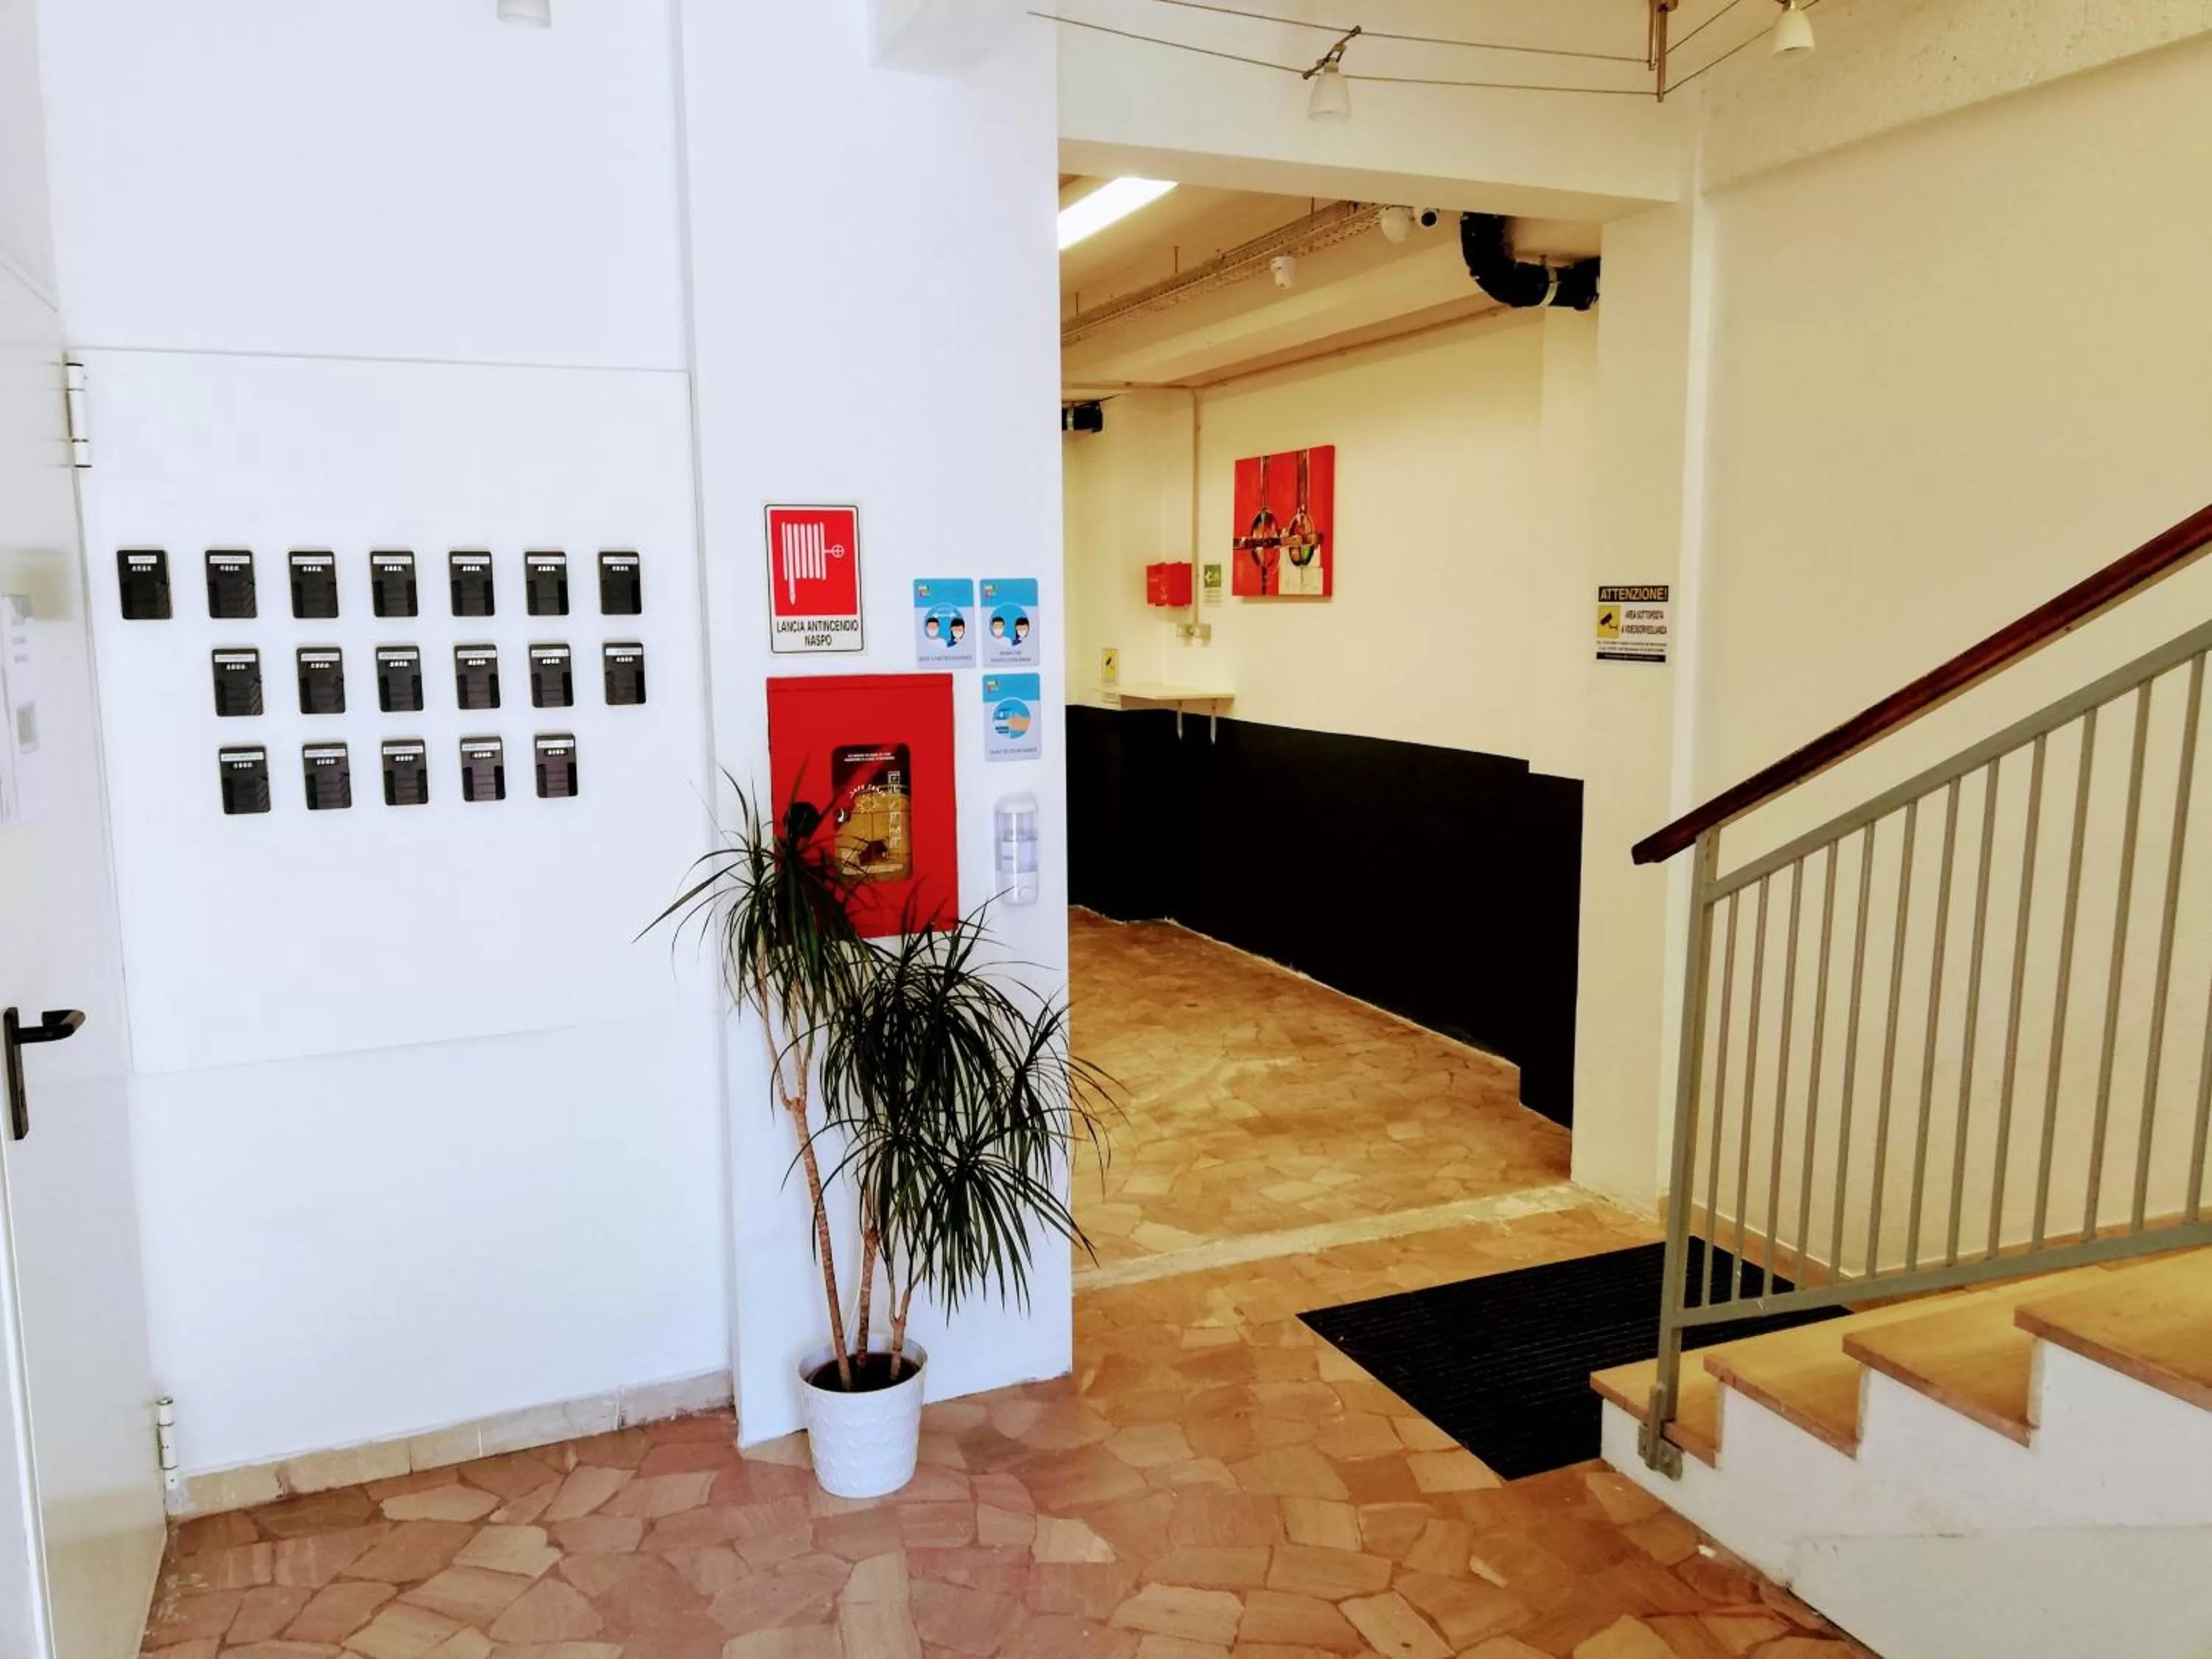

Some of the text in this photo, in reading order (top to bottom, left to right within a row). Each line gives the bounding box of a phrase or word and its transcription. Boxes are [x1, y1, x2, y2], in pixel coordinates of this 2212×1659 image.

[776, 619, 859, 633] LANCIA ANTINCENDIO
[804, 634, 832, 647] NASPO
